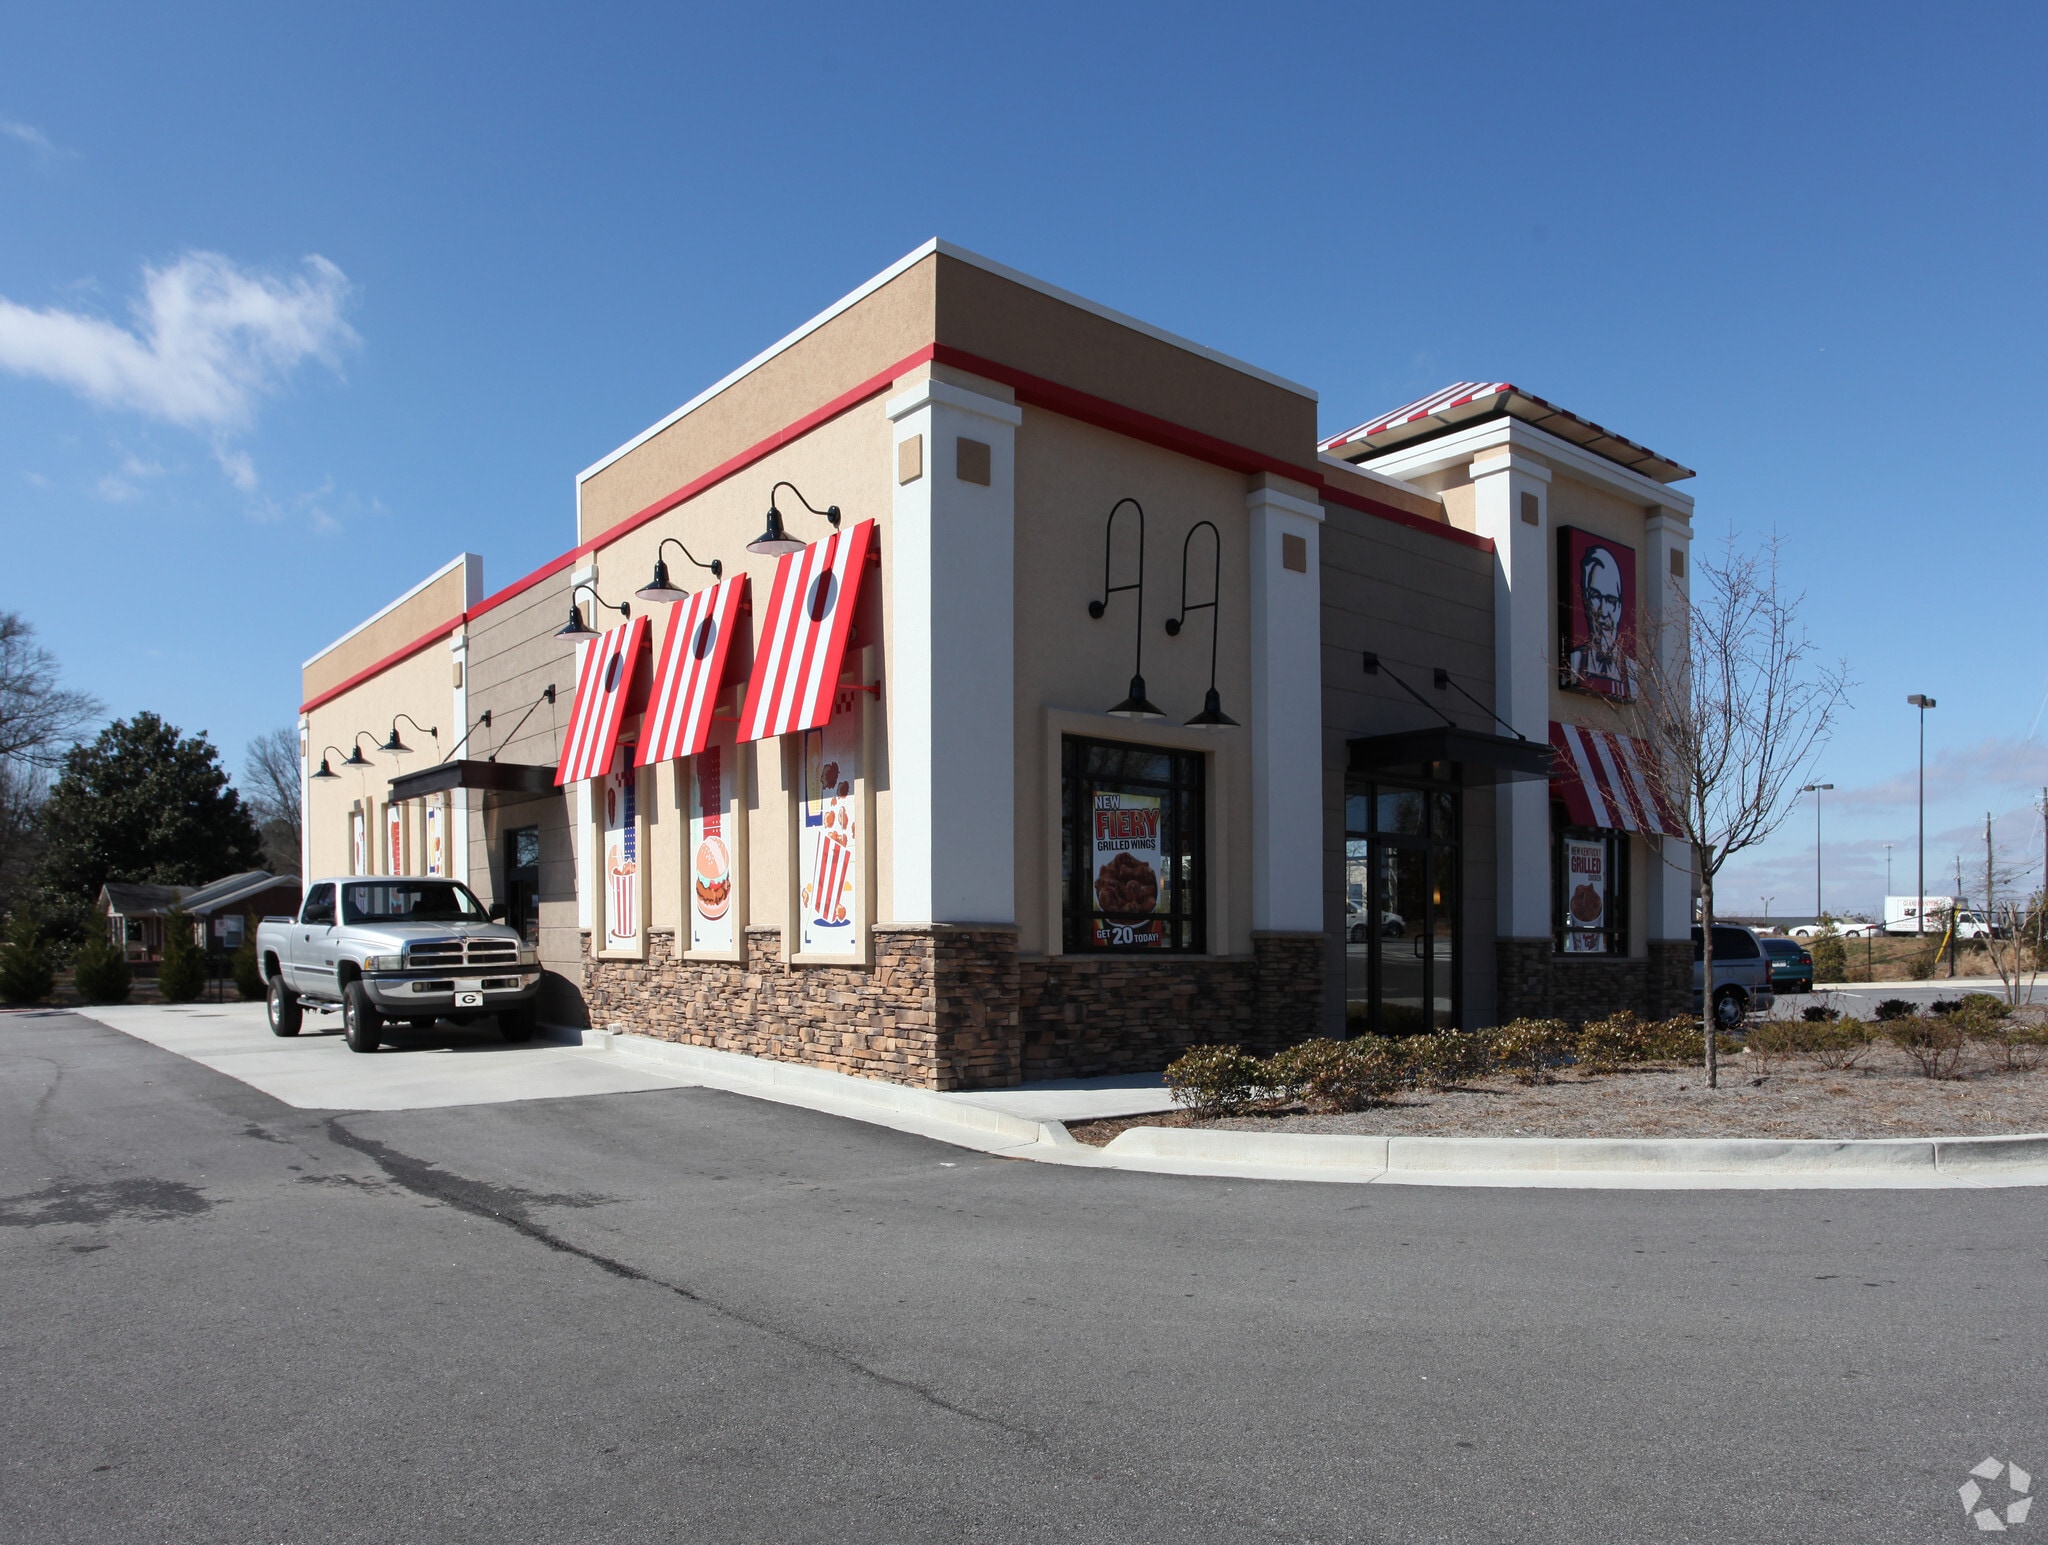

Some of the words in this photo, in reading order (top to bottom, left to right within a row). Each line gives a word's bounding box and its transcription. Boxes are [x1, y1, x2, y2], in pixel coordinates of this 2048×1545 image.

[1094, 794, 1120, 809] NEW
[1095, 807, 1160, 840] FIERY
[1097, 840, 1130, 851] GRILLED
[1131, 839, 1156, 849] WINGS
[1571, 855, 1601, 874] GRILLED
[1096, 929, 1111, 939] GET
[1112, 927, 1134, 945] 20
[1134, 933, 1159, 943] TODAY!
[462, 995, 476, 1004] G
